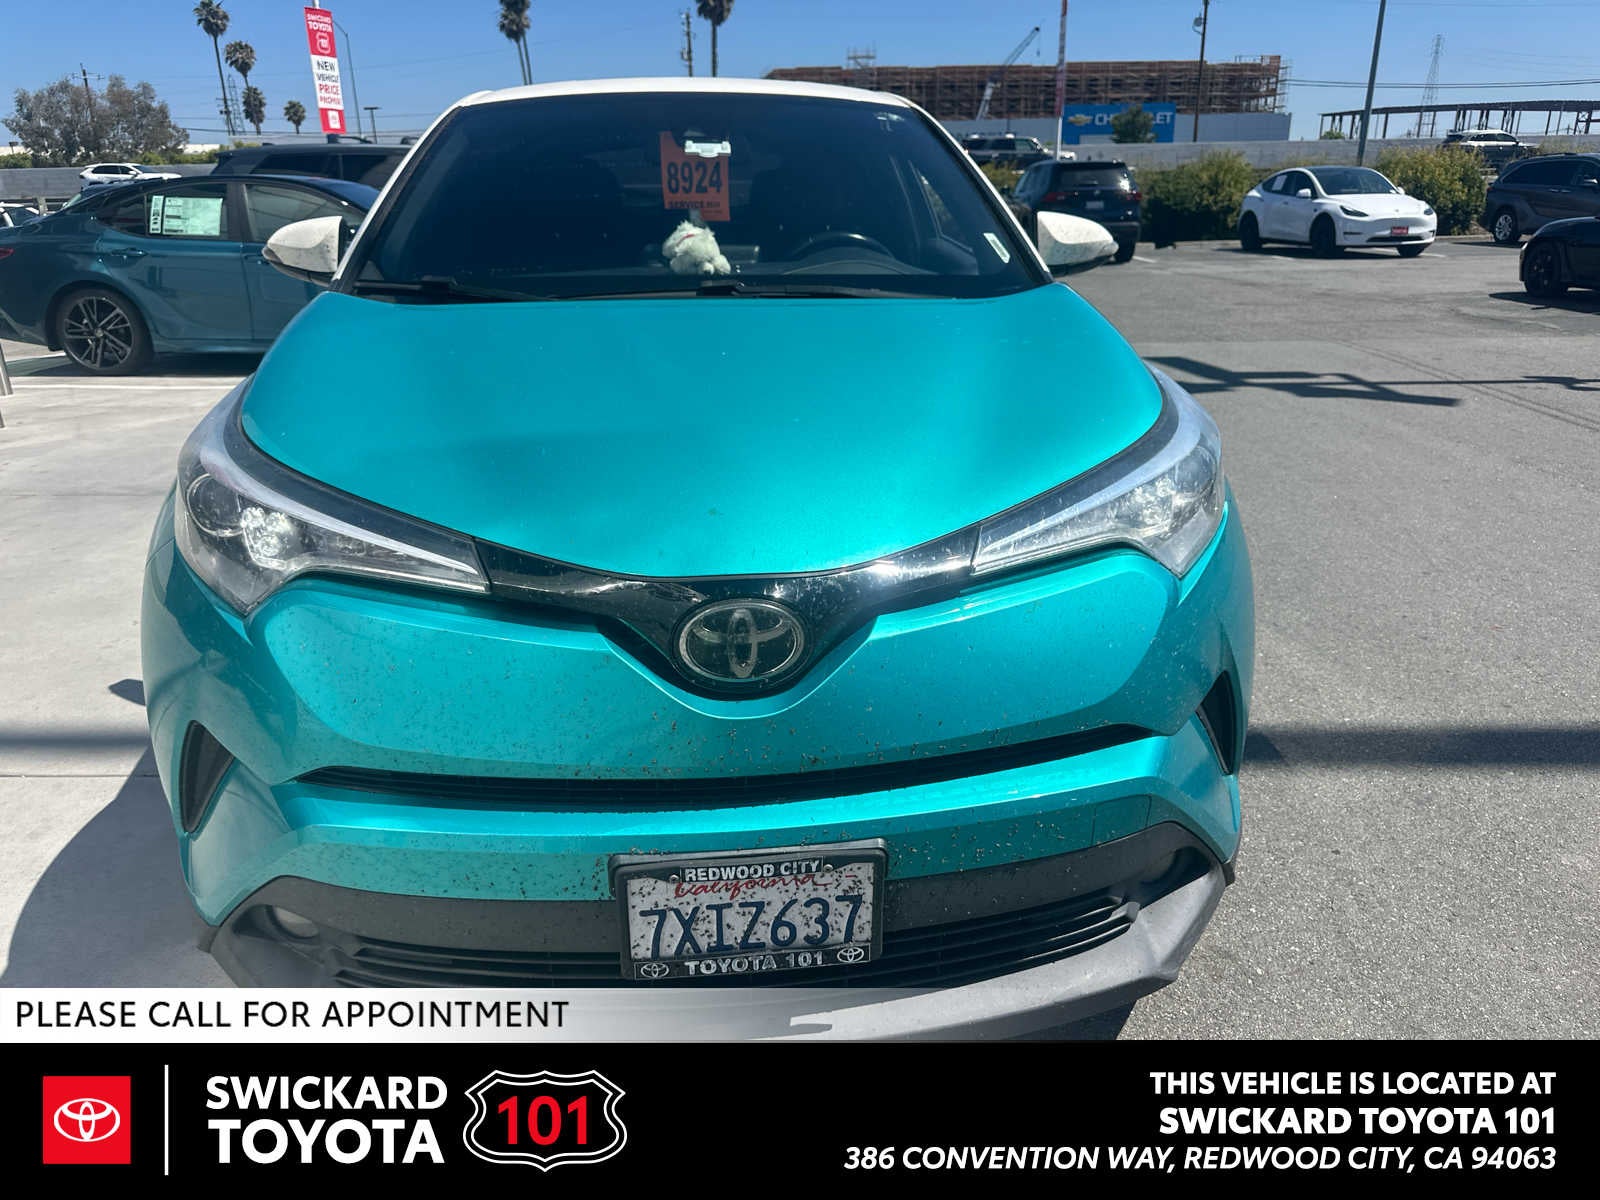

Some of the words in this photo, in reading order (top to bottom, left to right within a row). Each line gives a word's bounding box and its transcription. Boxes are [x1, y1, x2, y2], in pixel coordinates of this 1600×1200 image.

[308, 21, 333, 32] TOYOTA
[316, 60, 336, 72] NEW
[319, 83, 340, 96] PRICE
[667, 161, 723, 194] 8924
[685, 864, 776, 883] REDWOOD
[782, 858, 820, 876] CITY
[674, 874, 834, 901] California
[639, 894, 863, 960] 7XIZ637
[684, 953, 777, 976] TOYOTA
[786, 951, 823, 967] 101
